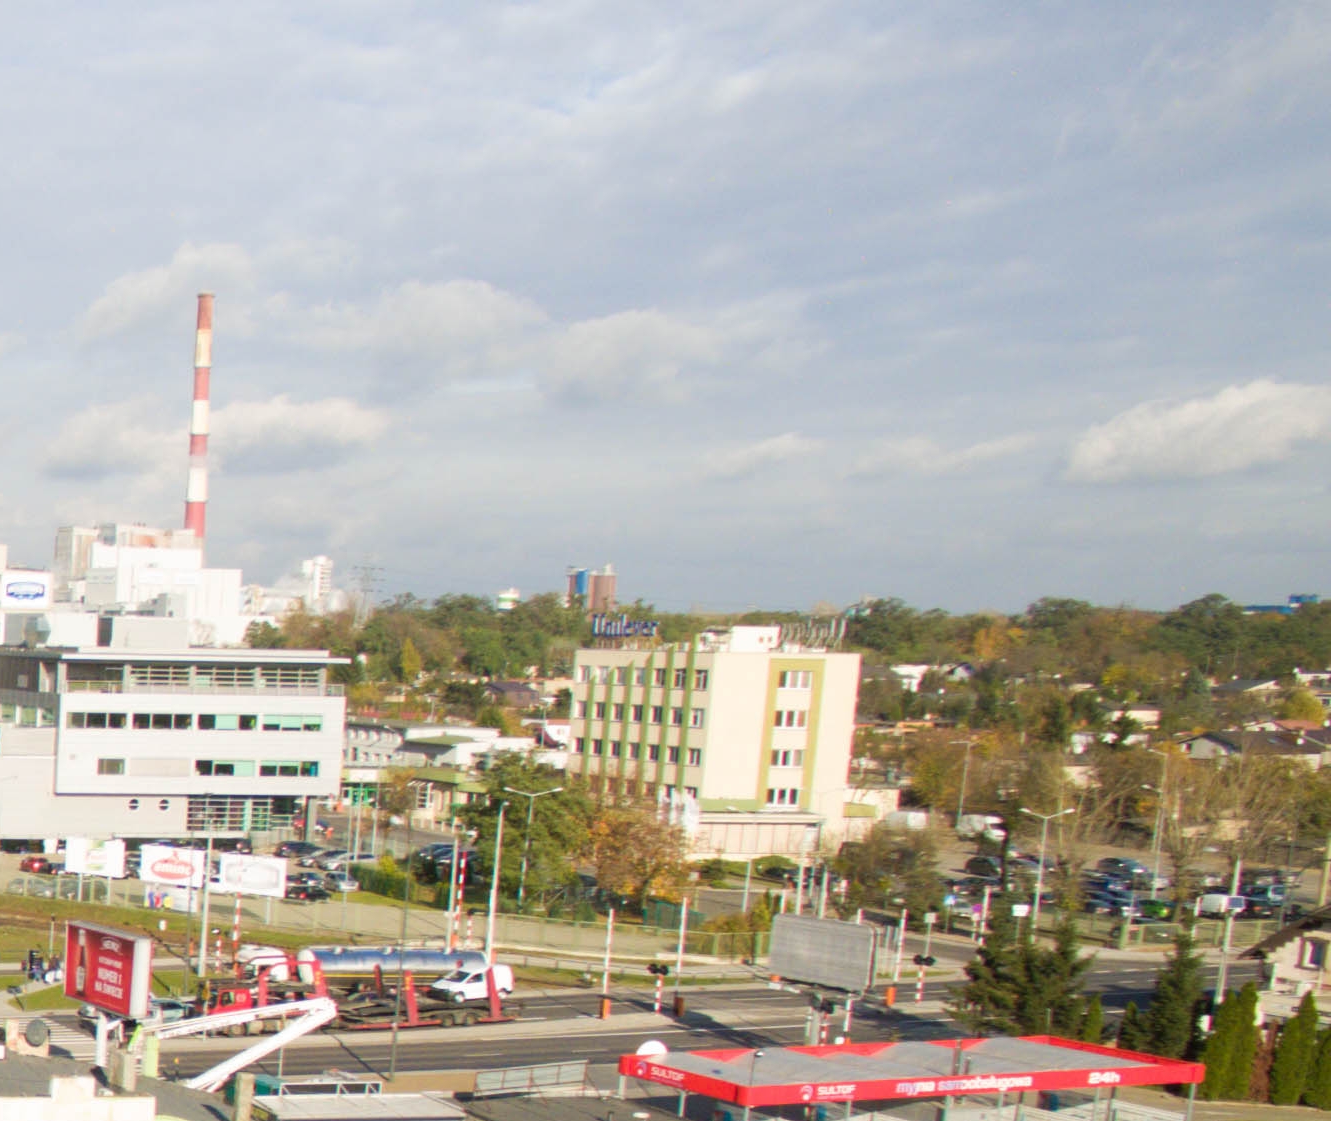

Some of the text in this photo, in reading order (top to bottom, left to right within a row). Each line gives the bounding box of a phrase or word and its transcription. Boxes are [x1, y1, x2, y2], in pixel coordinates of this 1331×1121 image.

[592, 613, 659, 637] Unilever
[1089, 1071, 1121, 1084] 24h
[817, 1085, 856, 1096] SULTOF
